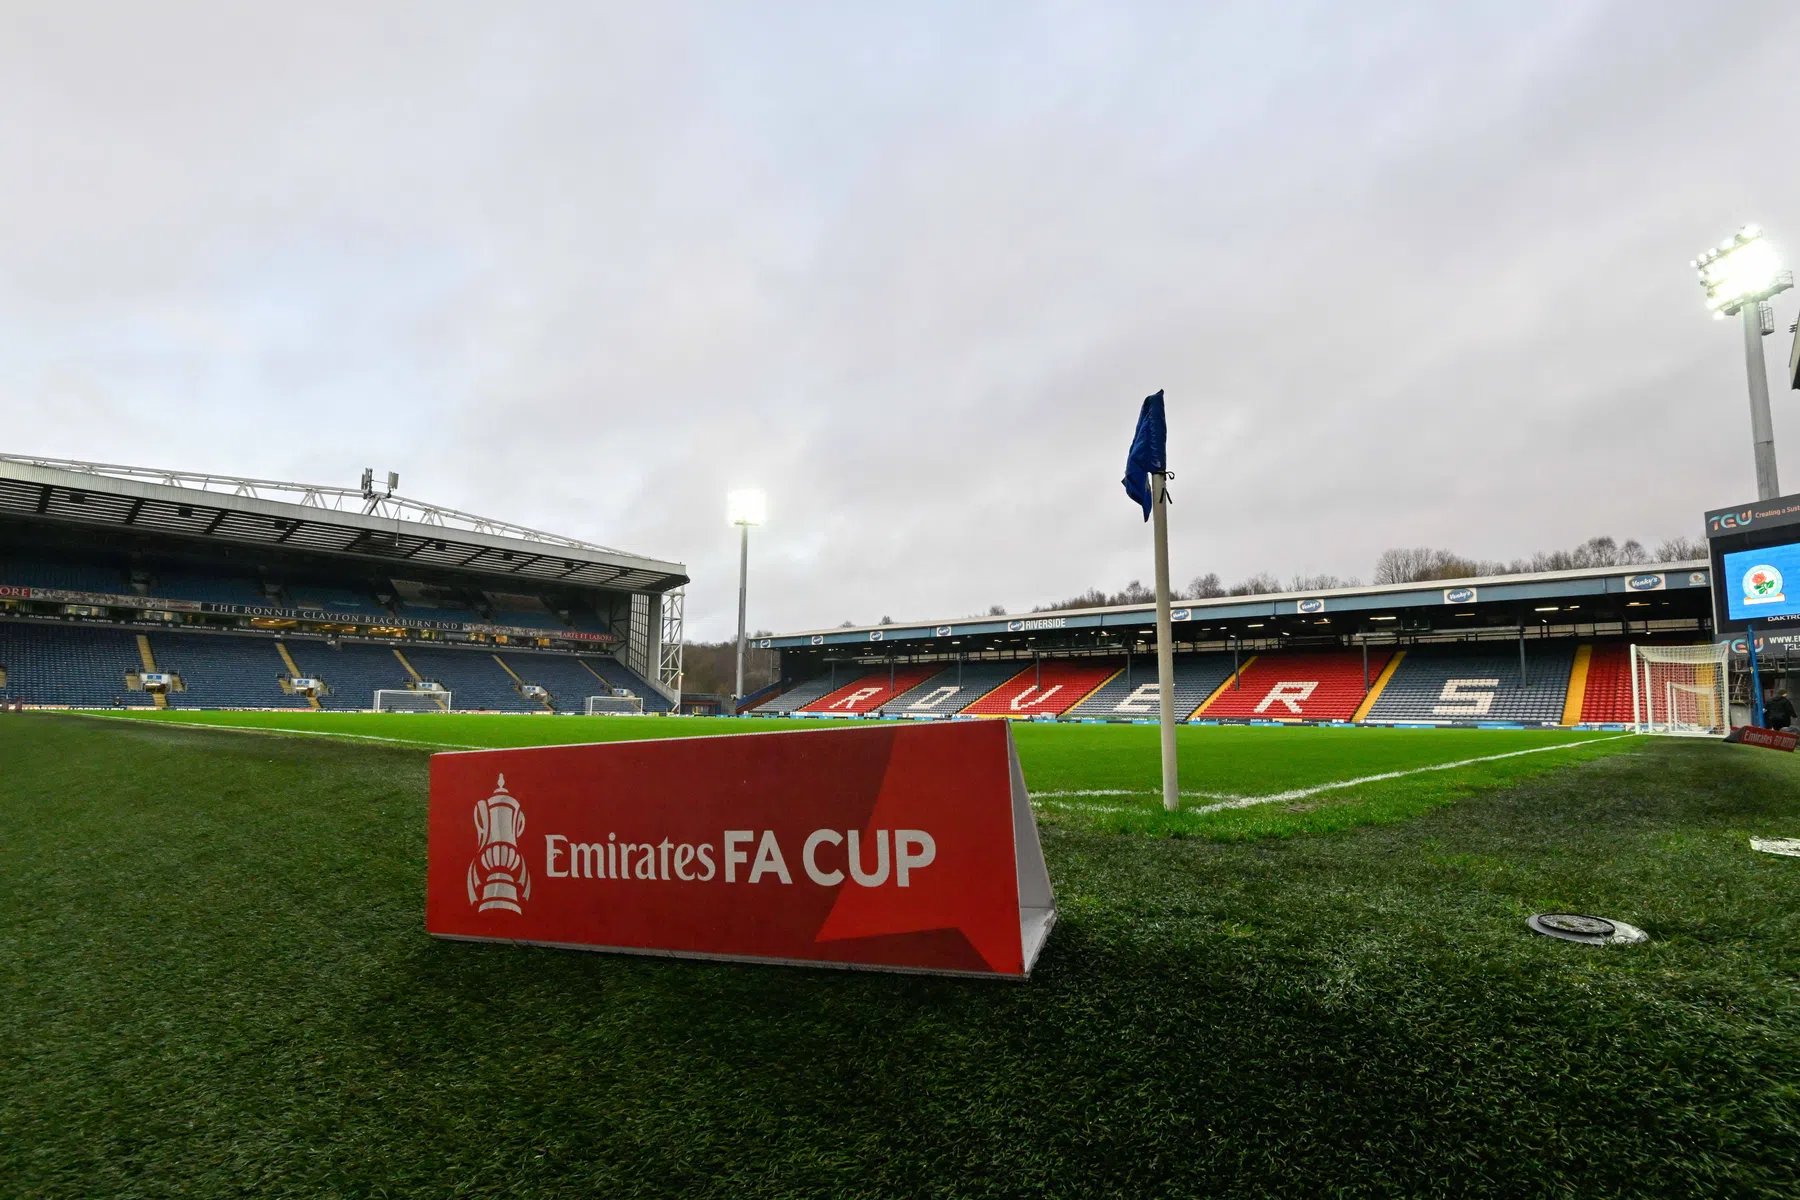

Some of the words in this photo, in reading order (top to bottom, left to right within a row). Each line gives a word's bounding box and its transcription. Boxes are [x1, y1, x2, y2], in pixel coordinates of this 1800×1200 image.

[1755, 509, 1781, 518] Creating
[211, 604, 237, 613] THE
[244, 604, 297, 618] RONNIE
[303, 611, 359, 622] CLAYTON
[365, 616, 432, 628] BLACKBURN
[436, 621, 458, 630] END
[1025, 618, 1066, 629] RIVERSIDE
[1769, 635, 1800, 644] WWW.E
[1744, 730, 1773, 744] Emirates
[544, 832, 716, 882] Emirates
[724, 830, 793, 885] FA
[802, 828, 936, 888] CUP
